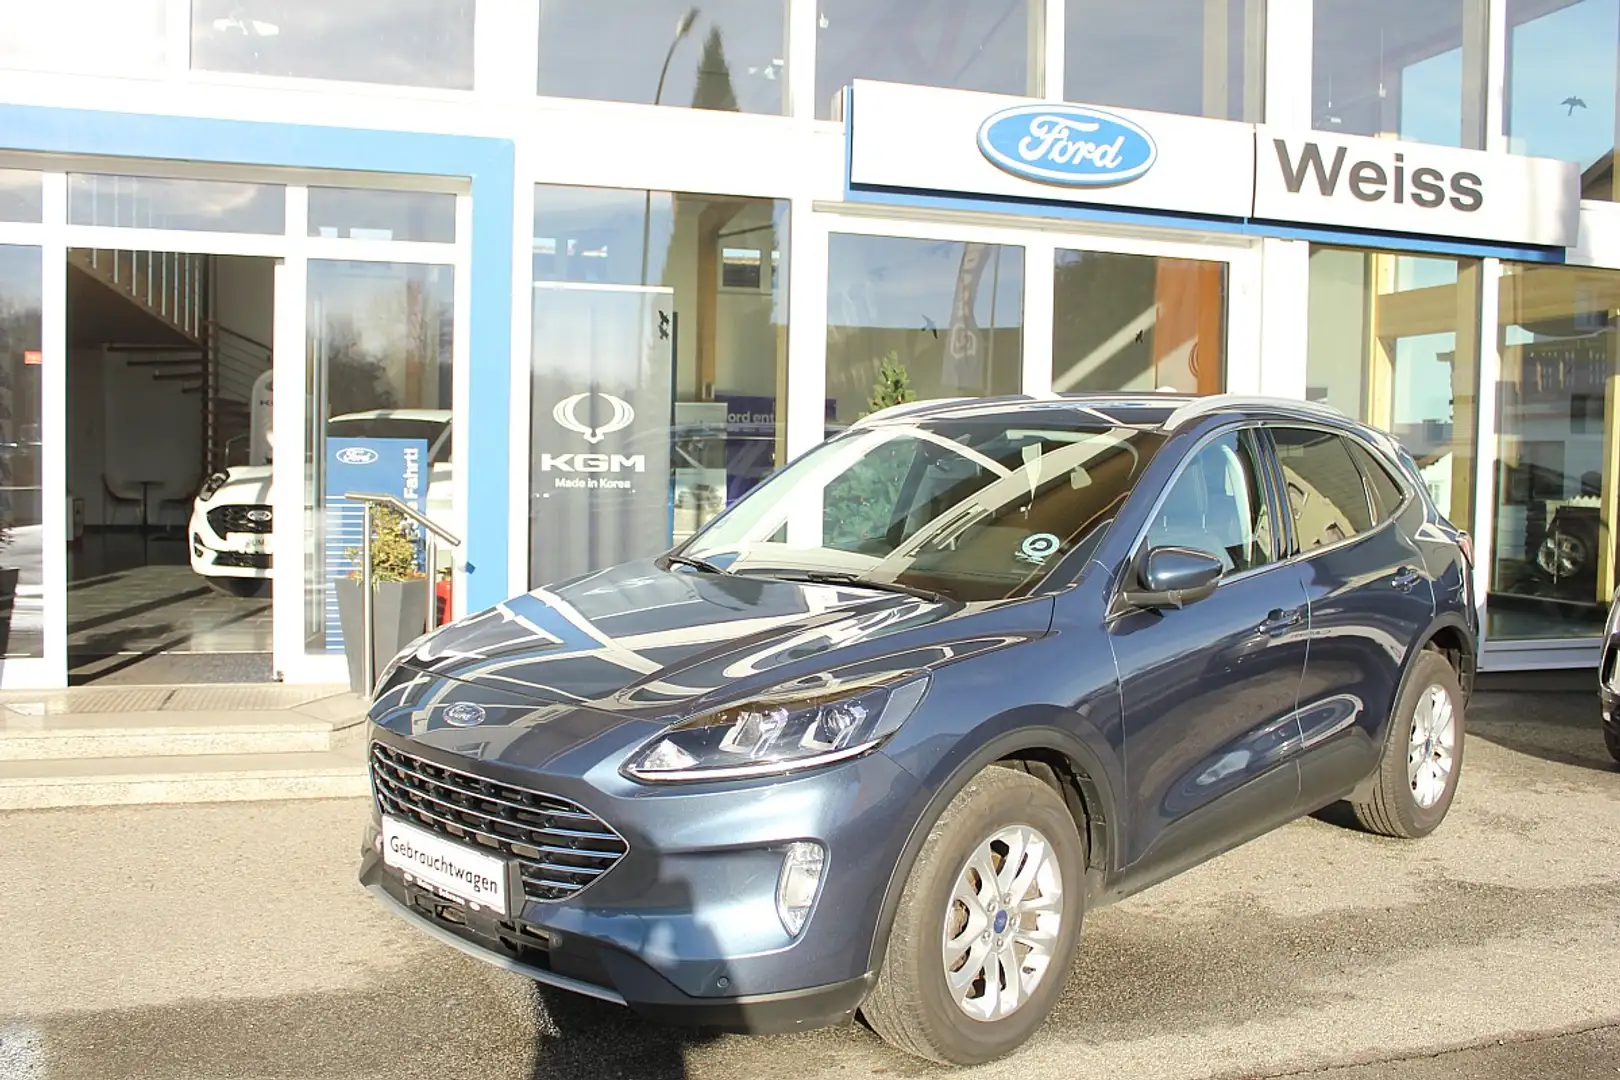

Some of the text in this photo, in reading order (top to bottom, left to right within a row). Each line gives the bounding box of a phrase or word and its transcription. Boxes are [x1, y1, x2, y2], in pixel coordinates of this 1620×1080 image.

[1018, 114, 1127, 169] Ford
[1272, 138, 1484, 212] Weiss
[727, 411, 751, 423] ord
[541, 453, 646, 473] KGM
[554, 478, 632, 489] Made in Korea
[389, 835, 499, 895] Gebrauchtwagen
